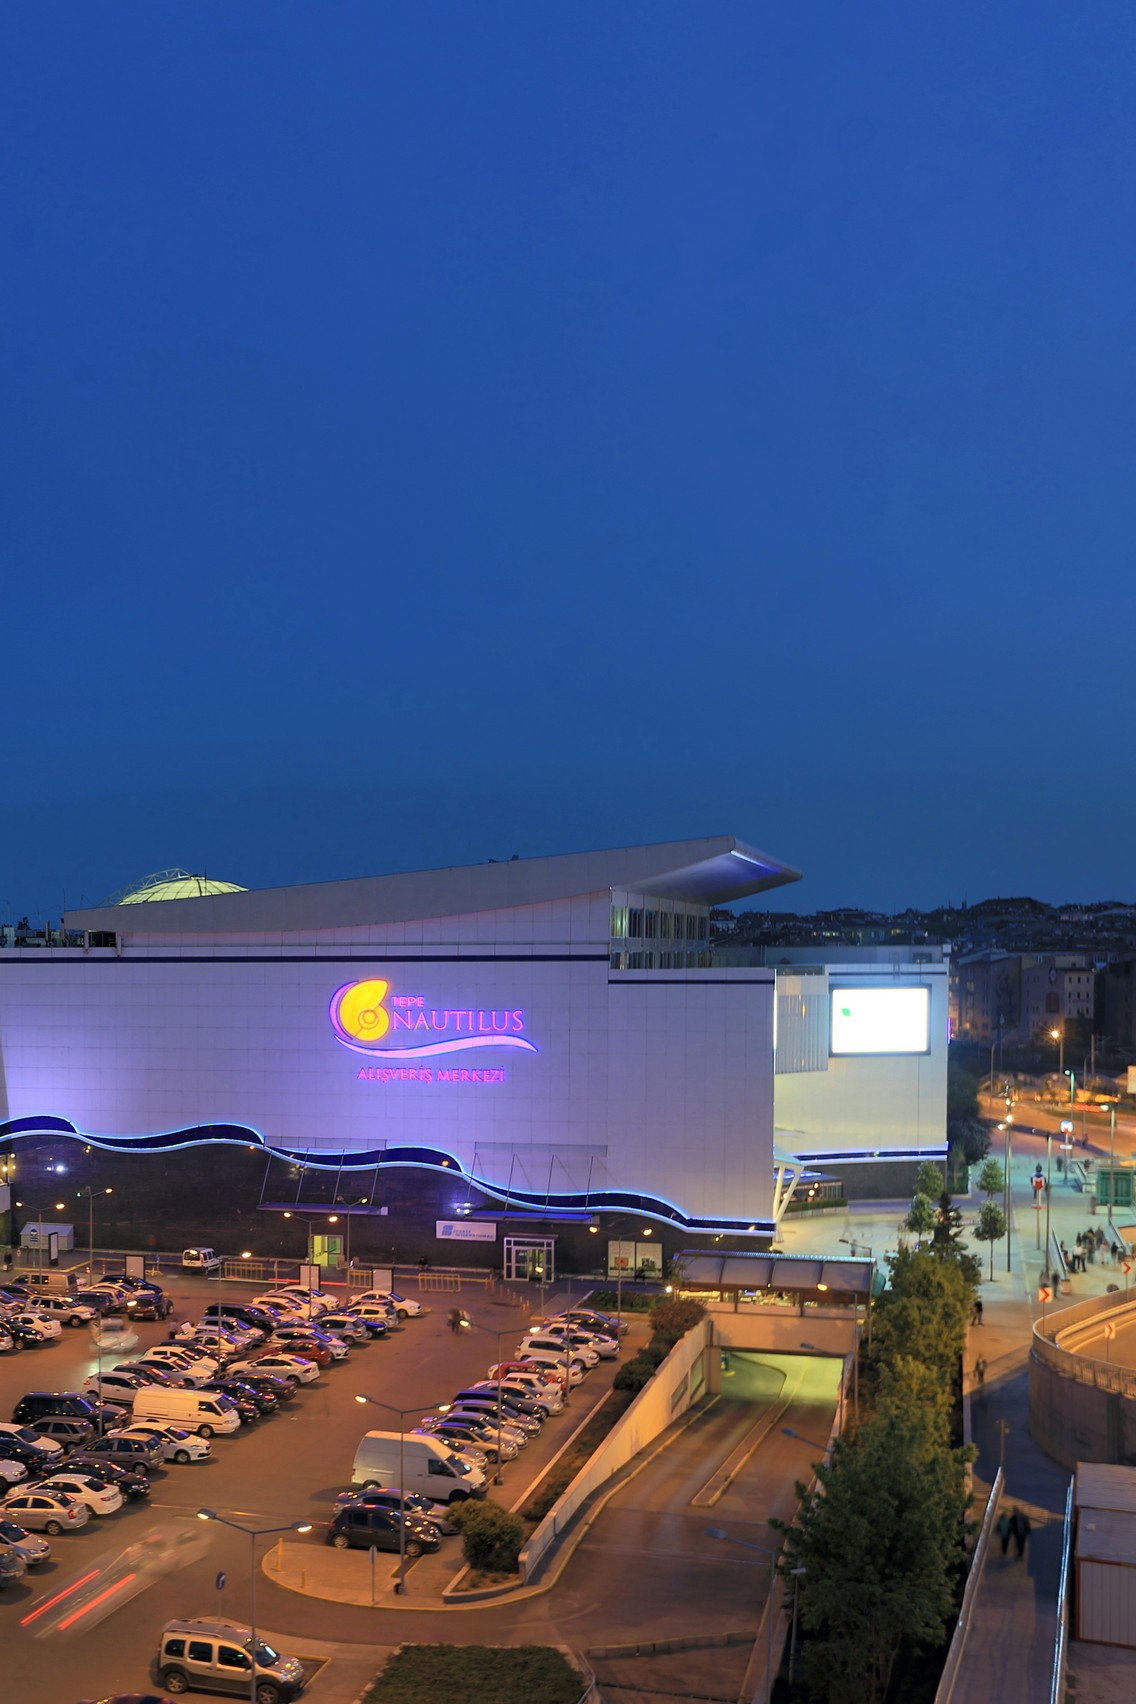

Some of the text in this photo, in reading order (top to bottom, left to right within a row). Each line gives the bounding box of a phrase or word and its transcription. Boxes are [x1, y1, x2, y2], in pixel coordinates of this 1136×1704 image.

[391, 995, 424, 1008] TEPE
[392, 1009, 524, 1032] NAUTILUS
[357, 1064, 505, 1084] ALIŞVERİŞ MERKEZİ
